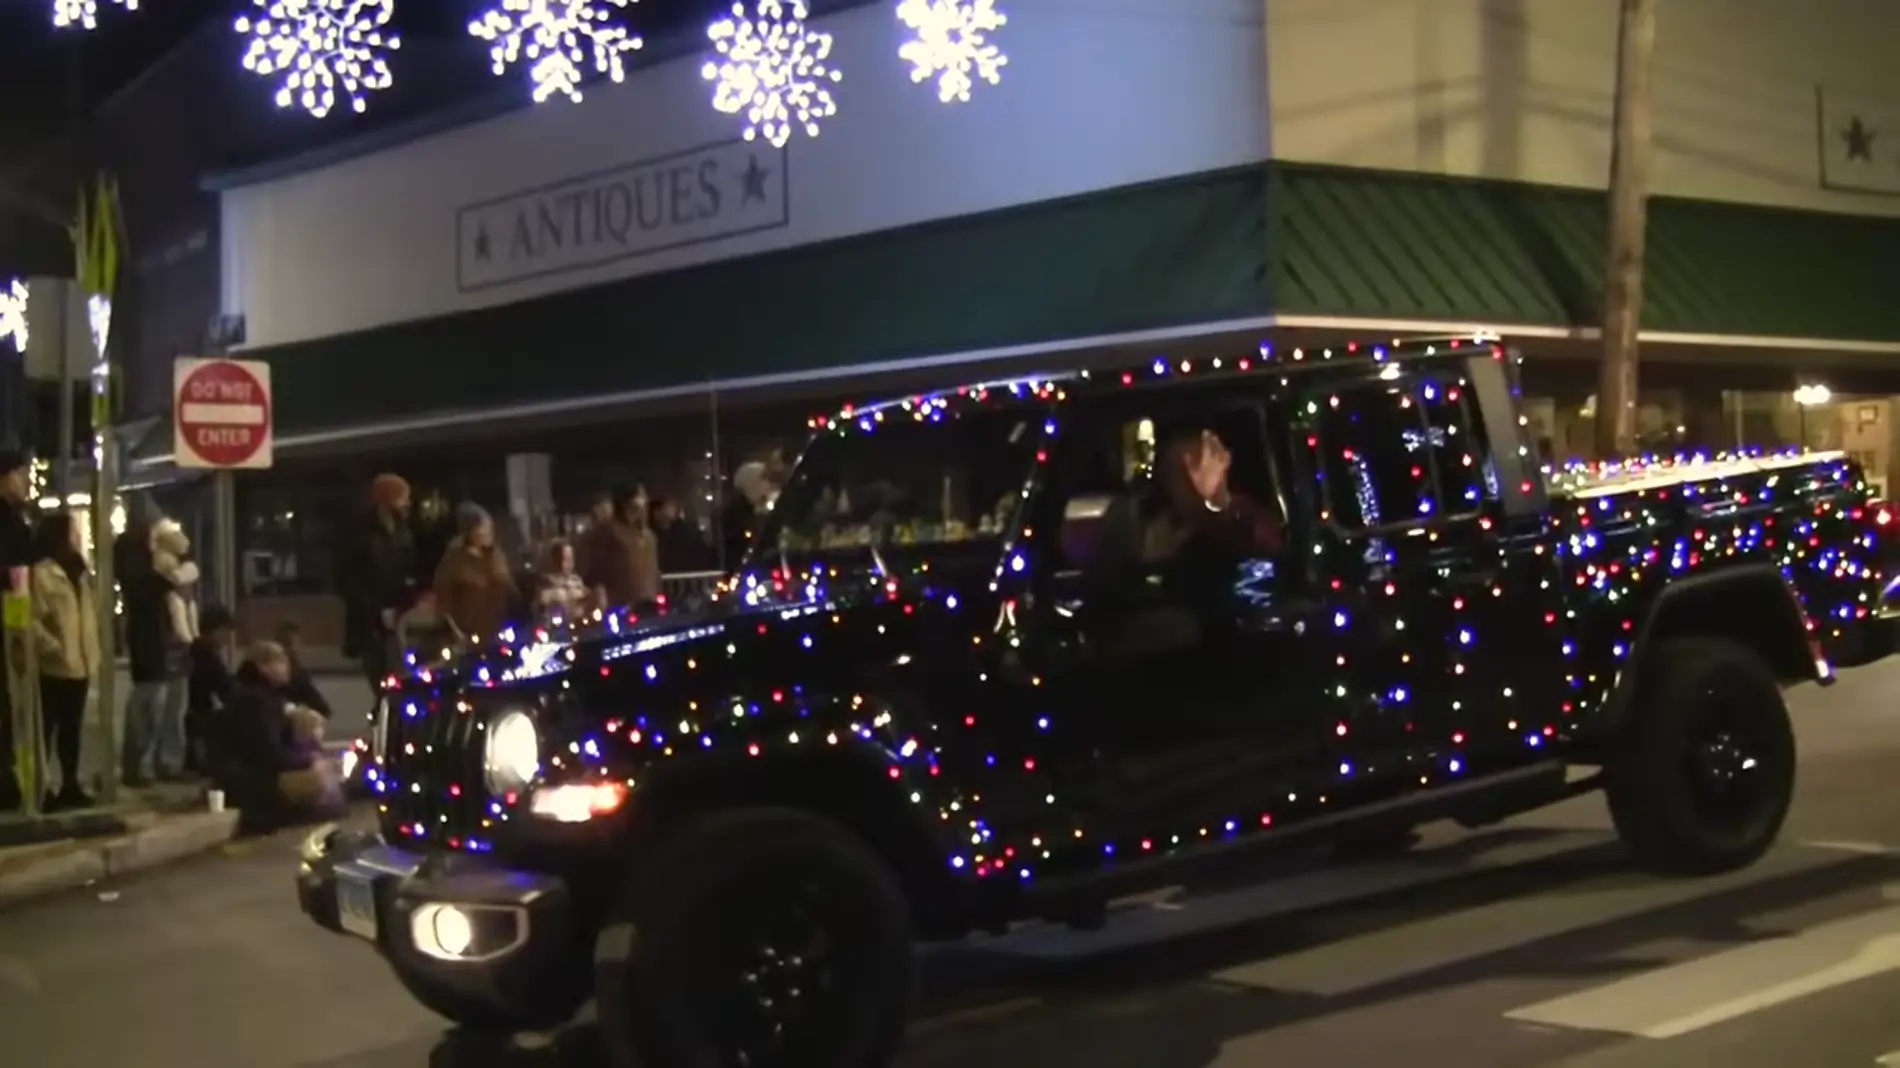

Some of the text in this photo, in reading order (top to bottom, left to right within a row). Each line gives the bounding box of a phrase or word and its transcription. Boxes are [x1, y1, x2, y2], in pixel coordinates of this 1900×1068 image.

[508, 159, 721, 260] ANTIQUES
[190, 381, 252, 400] DO NOT
[197, 428, 252, 447] ENTER
